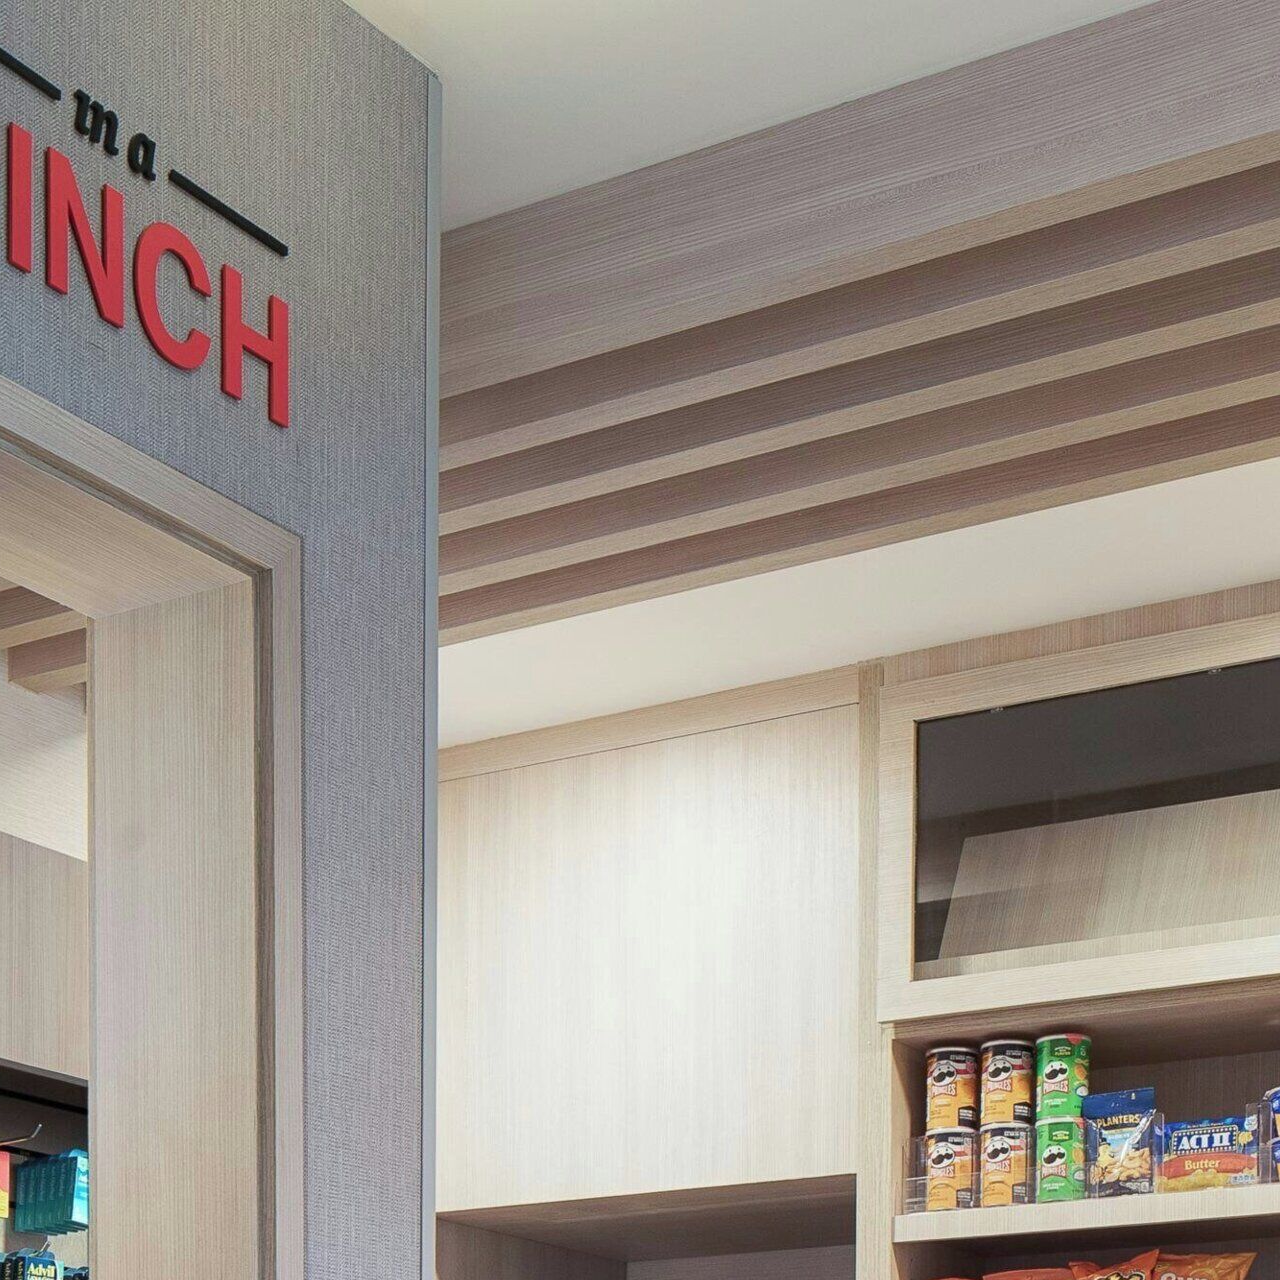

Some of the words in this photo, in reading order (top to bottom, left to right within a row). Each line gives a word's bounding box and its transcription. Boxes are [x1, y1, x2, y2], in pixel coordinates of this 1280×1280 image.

[74, 89, 119, 156] in
[128, 133, 156, 181] a
[1097, 1114, 1141, 1128] PLANTERS
[1178, 1134, 1210, 1150] ACT
[1212, 1132, 1231, 1147] II
[1184, 1159, 1221, 1170] Butter
[27, 1262, 56, 1277] Advil
